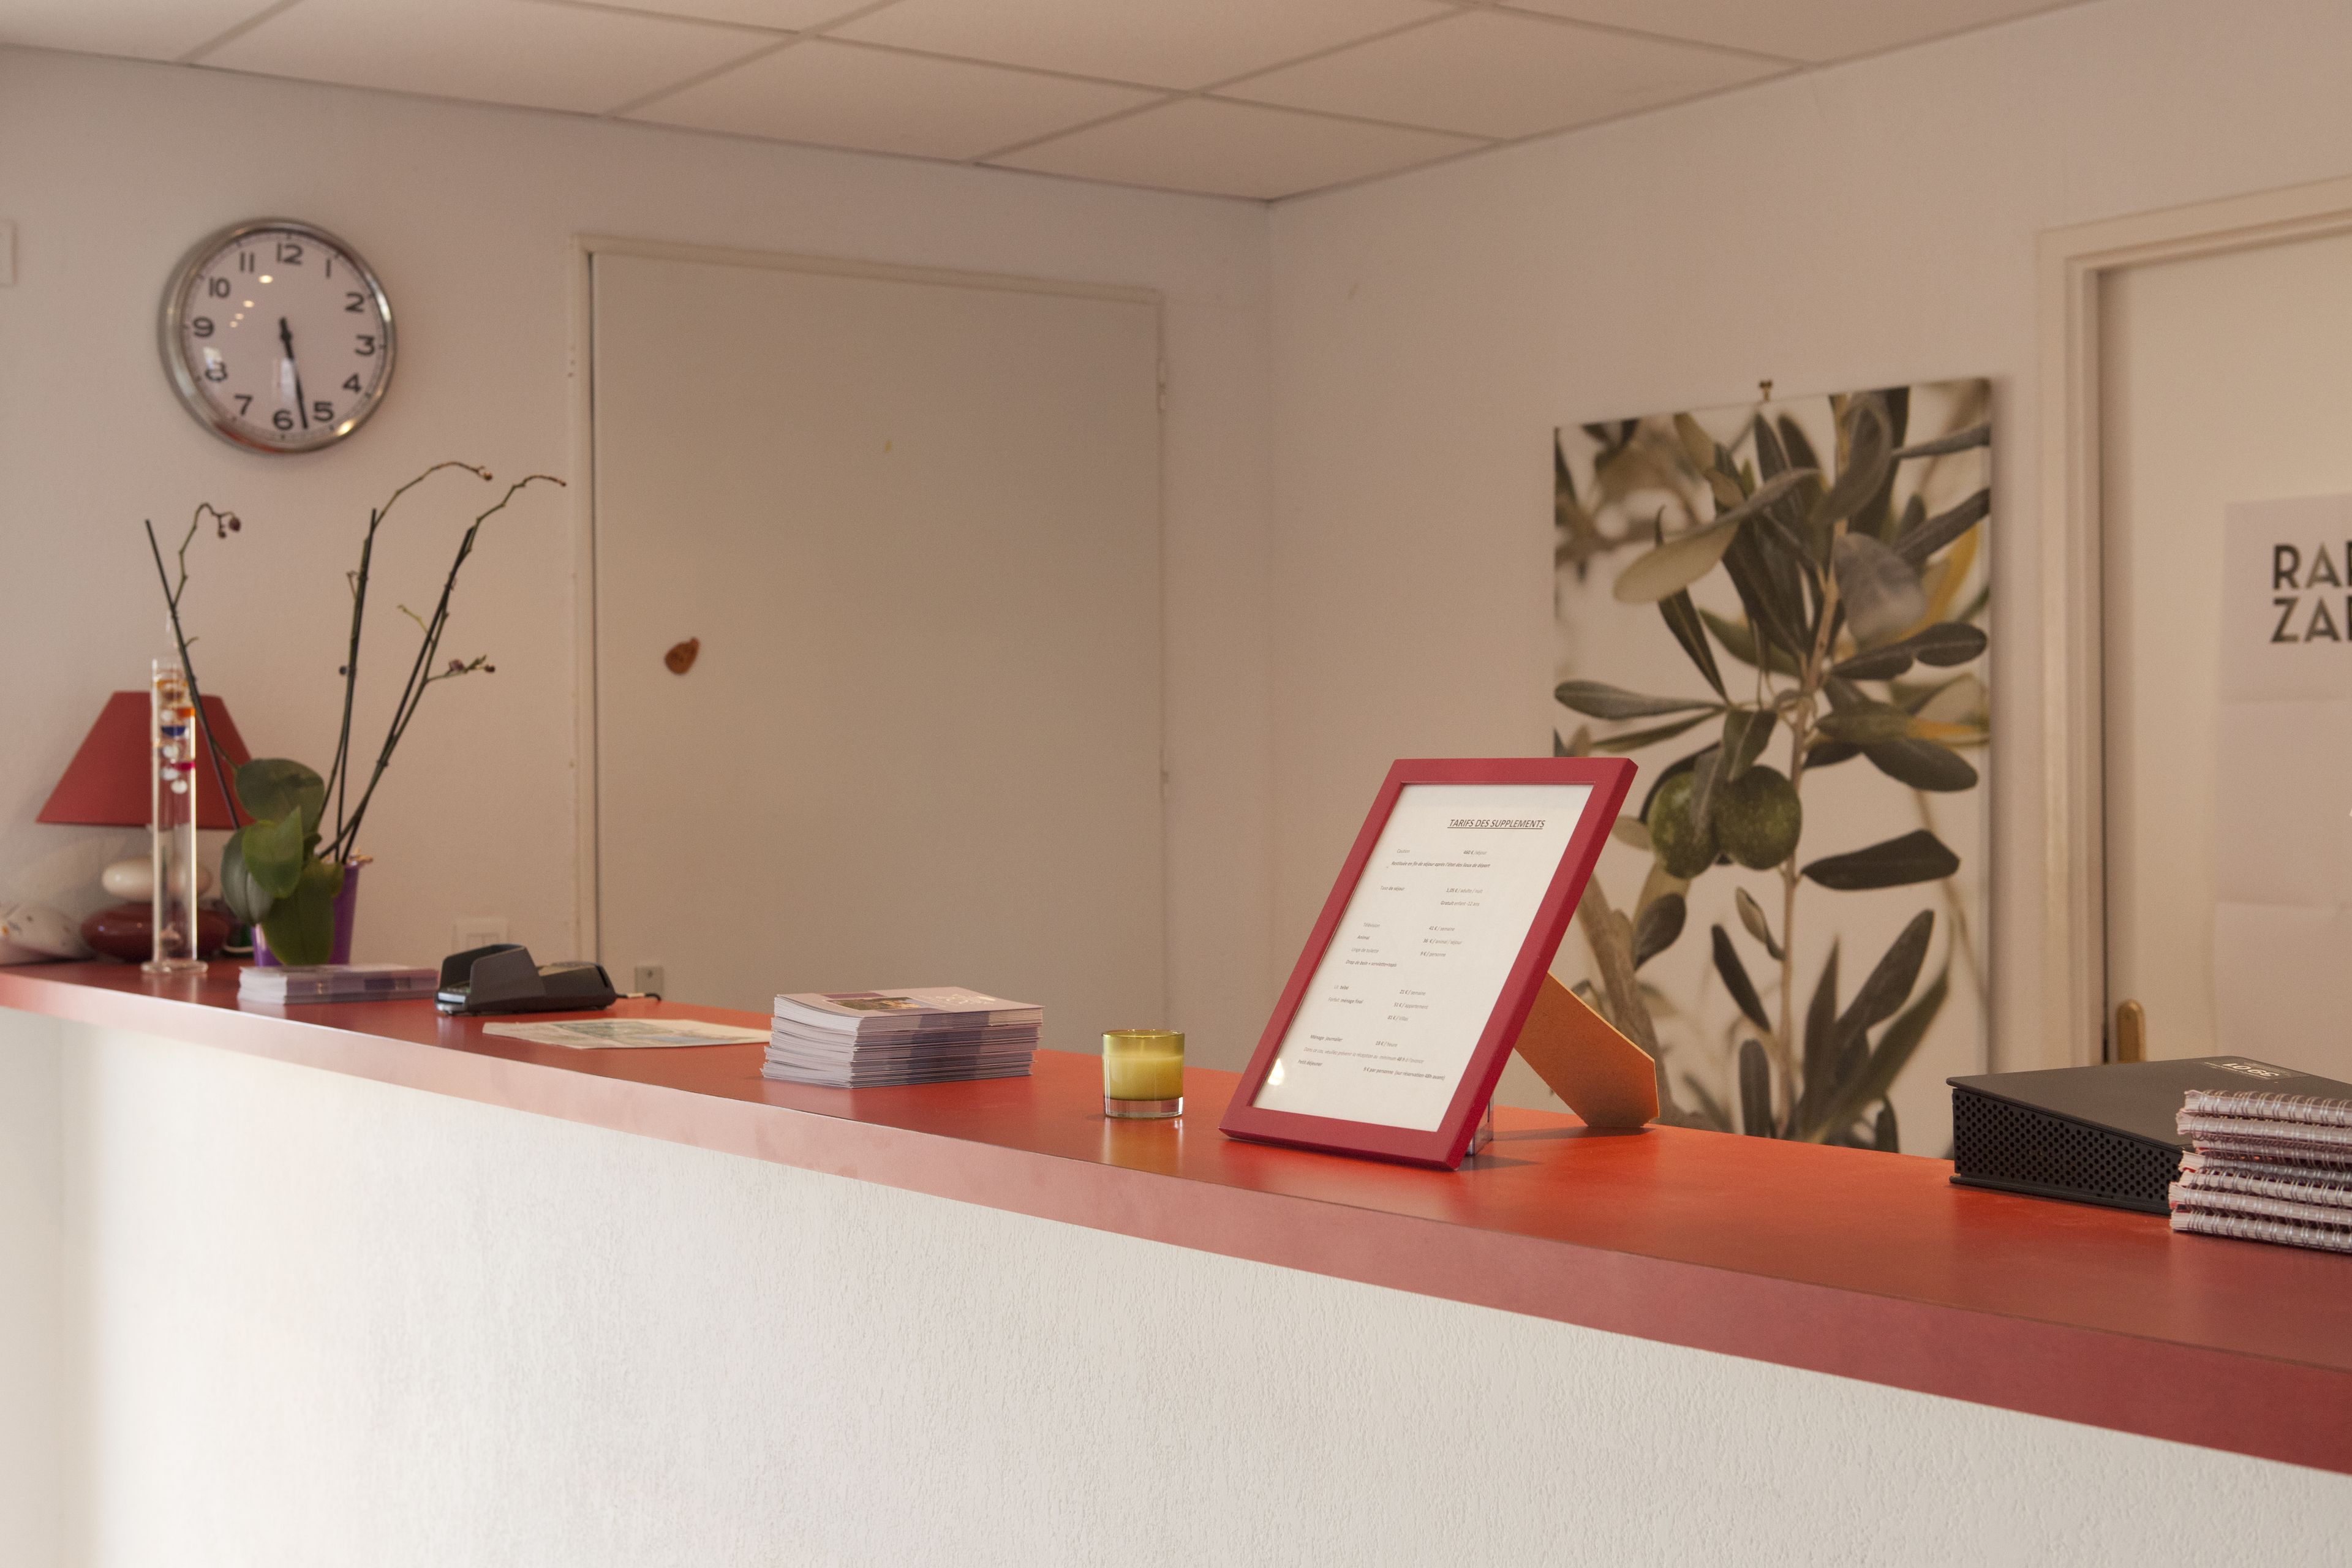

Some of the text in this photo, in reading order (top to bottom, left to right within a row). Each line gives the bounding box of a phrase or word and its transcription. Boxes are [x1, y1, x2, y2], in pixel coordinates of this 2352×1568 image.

[239, 252, 255, 273] 11
[276, 243, 304, 265] 12
[325, 258, 331, 278] 1
[208, 277, 230, 298] 10
[345, 293, 364, 313] 2
[192, 317, 214, 337] 9
[355, 334, 375, 356] 3
[342, 373, 362, 393] 4
[235, 395, 252, 416] 7
[313, 402, 334, 421] 5
[273, 409, 293, 431] 6
[2273, 540, 2352, 589] RA
[2272, 595, 2352, 642] ZA
[1449, 819, 1475, 827] TARIFS
[1490, 820, 1545, 828] SUPPLEMENTS
